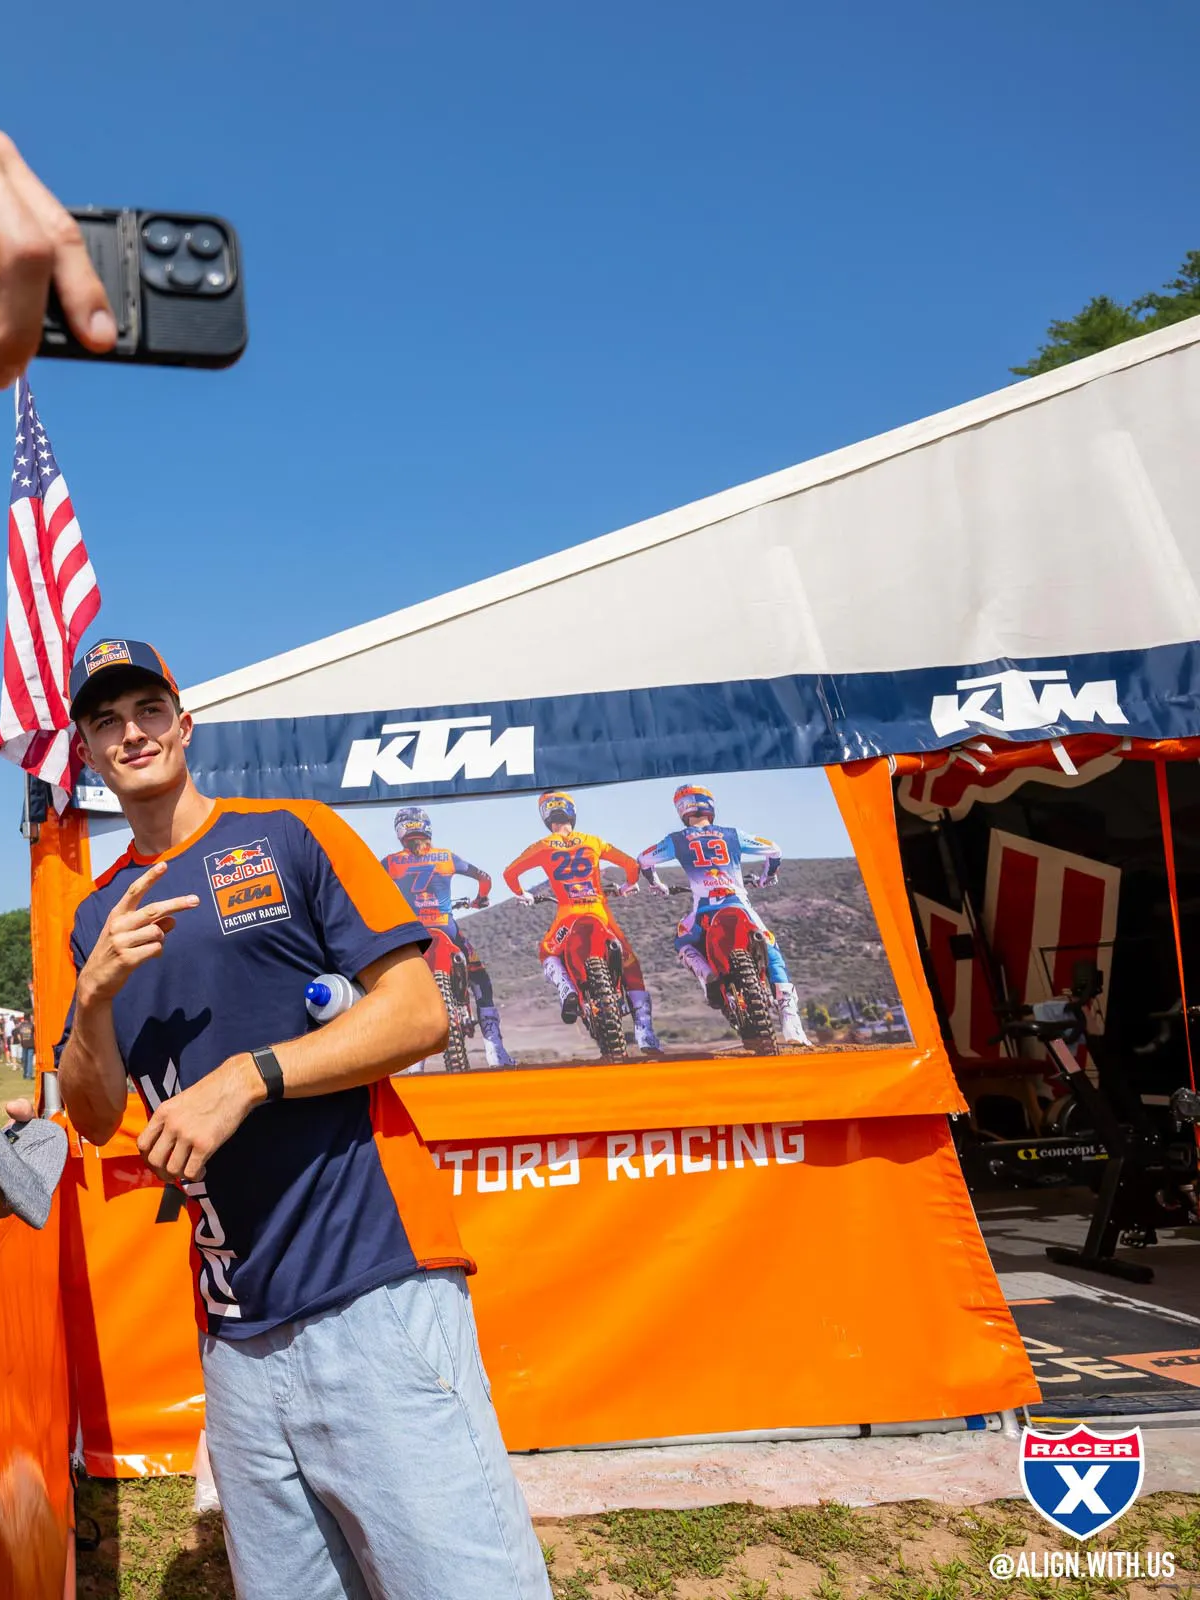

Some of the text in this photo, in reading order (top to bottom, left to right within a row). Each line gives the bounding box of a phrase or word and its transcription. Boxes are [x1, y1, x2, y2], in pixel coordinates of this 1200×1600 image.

[88, 650, 128, 672] Red Bull
[930, 669, 1129, 738] KTM
[340, 715, 535, 788] KTM
[551, 848, 593, 880] 26
[689, 839, 730, 867] 13
[211, 857, 274, 889] Red Bull
[406, 864, 436, 893] 7
[227, 884, 272, 908] KTM
[224, 905, 287, 928] FACTORY RACING
[1040, 1145, 1096, 1157] concept
[429, 1138, 580, 1196] TORY
